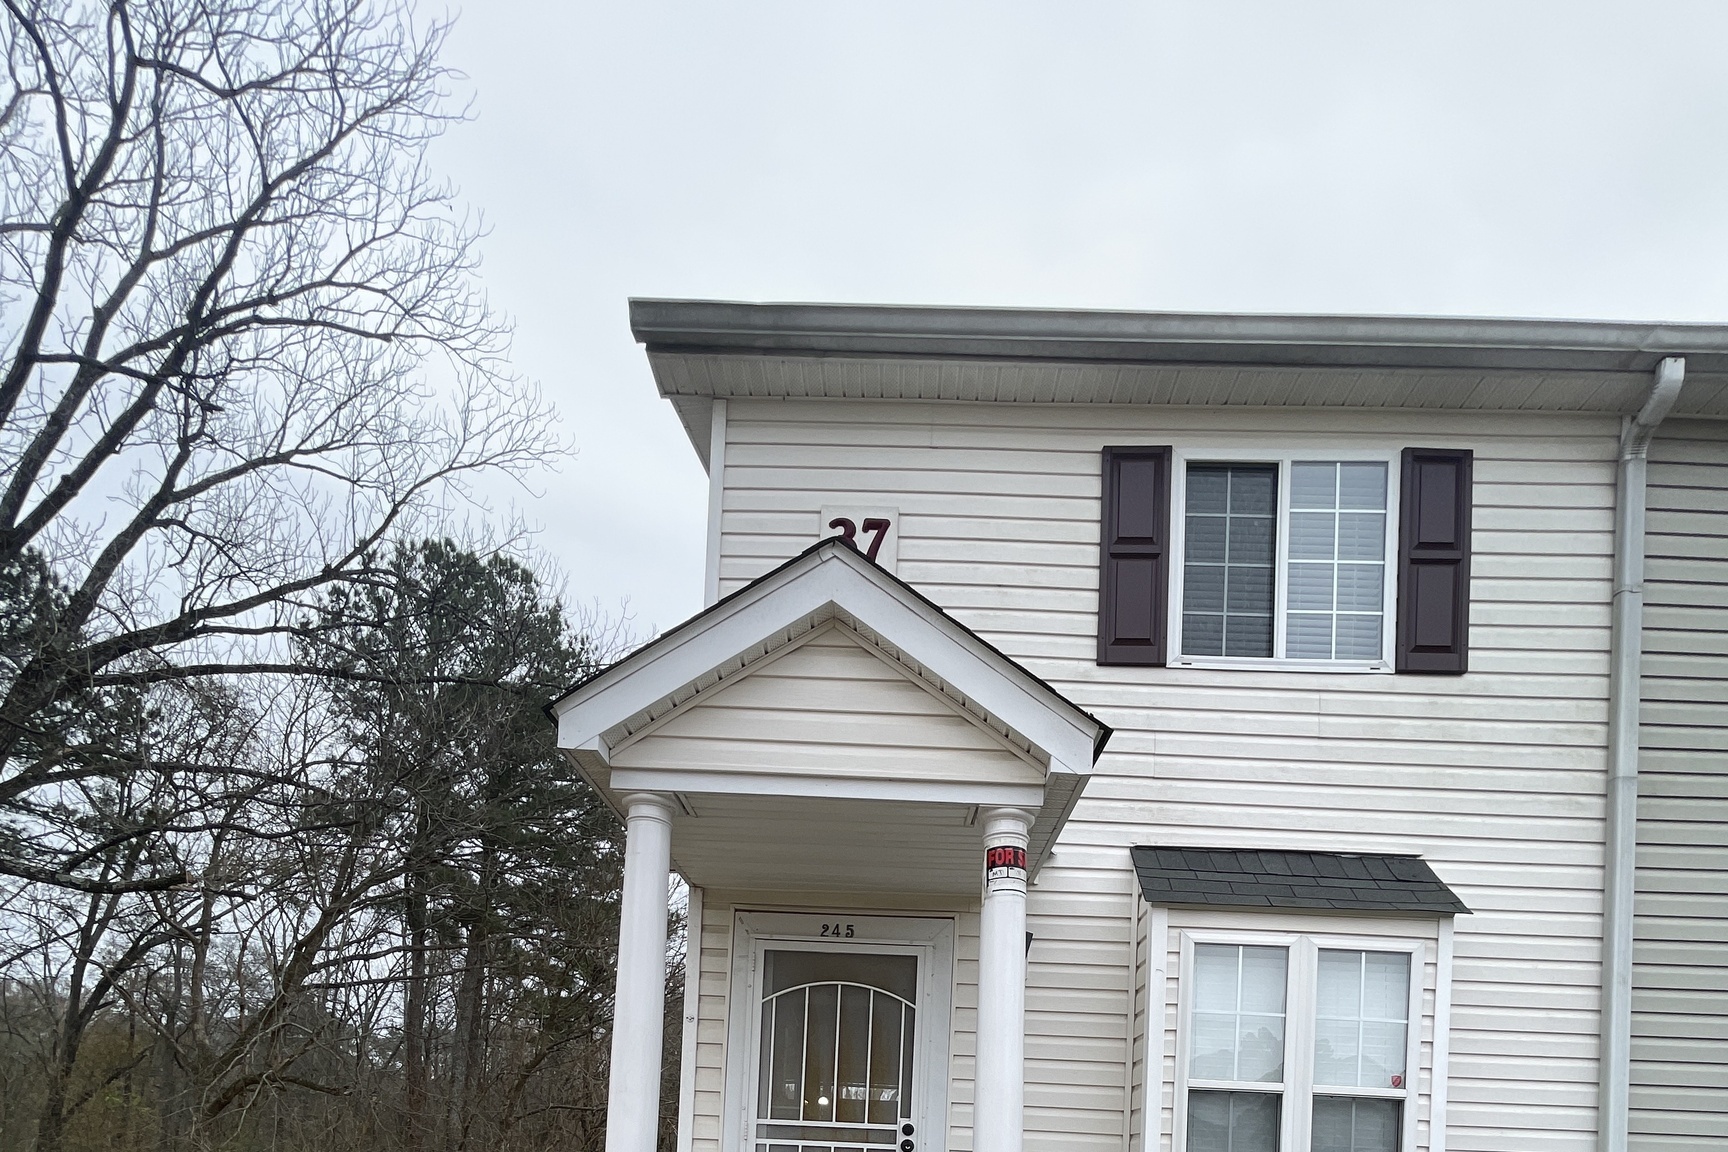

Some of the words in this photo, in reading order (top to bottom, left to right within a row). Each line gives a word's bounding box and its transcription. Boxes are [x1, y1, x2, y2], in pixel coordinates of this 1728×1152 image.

[988, 848, 1014, 867] FOR
[1017, 849, 1027, 868] S
[820, 923, 854, 938] 245
